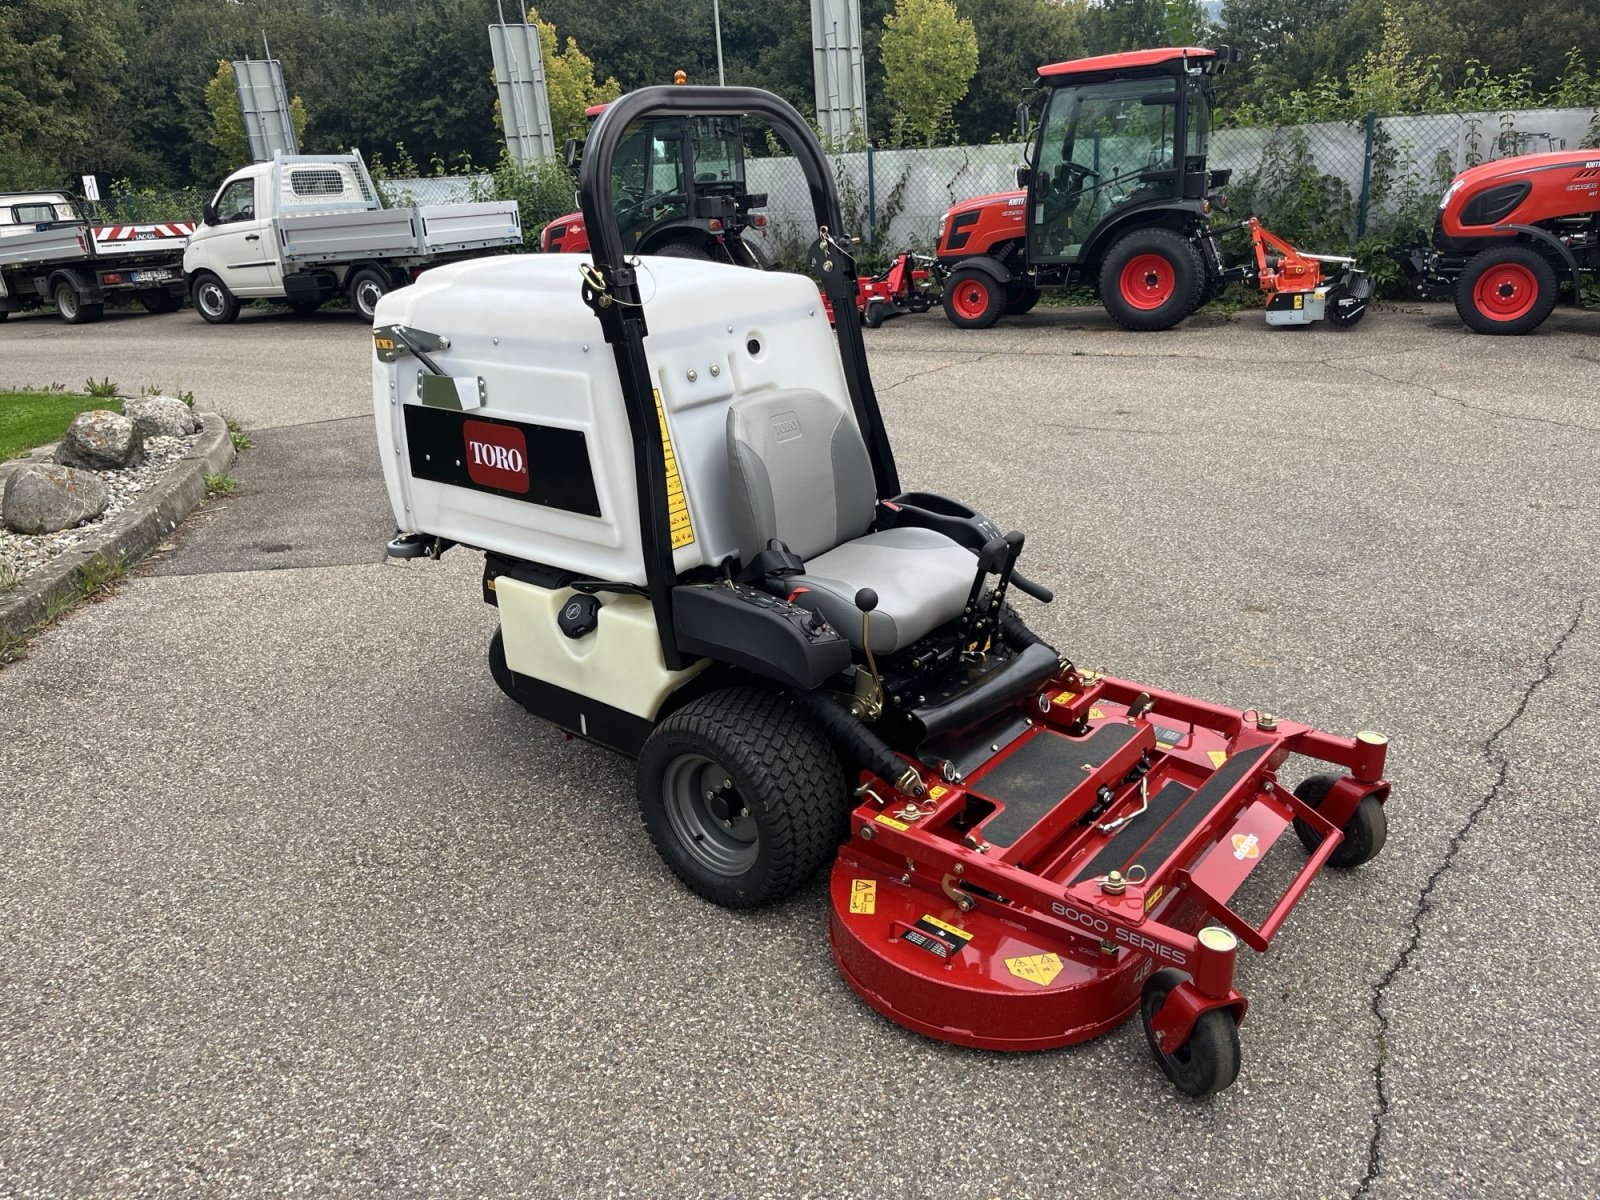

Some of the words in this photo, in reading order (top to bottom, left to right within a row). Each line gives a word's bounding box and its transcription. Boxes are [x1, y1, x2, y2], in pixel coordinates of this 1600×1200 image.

[1008, 197, 1025, 206] KIOTI
[469, 440, 524, 473] TORO
[1051, 902, 1108, 933] 8000
[1115, 927, 1187, 965] SERIES
